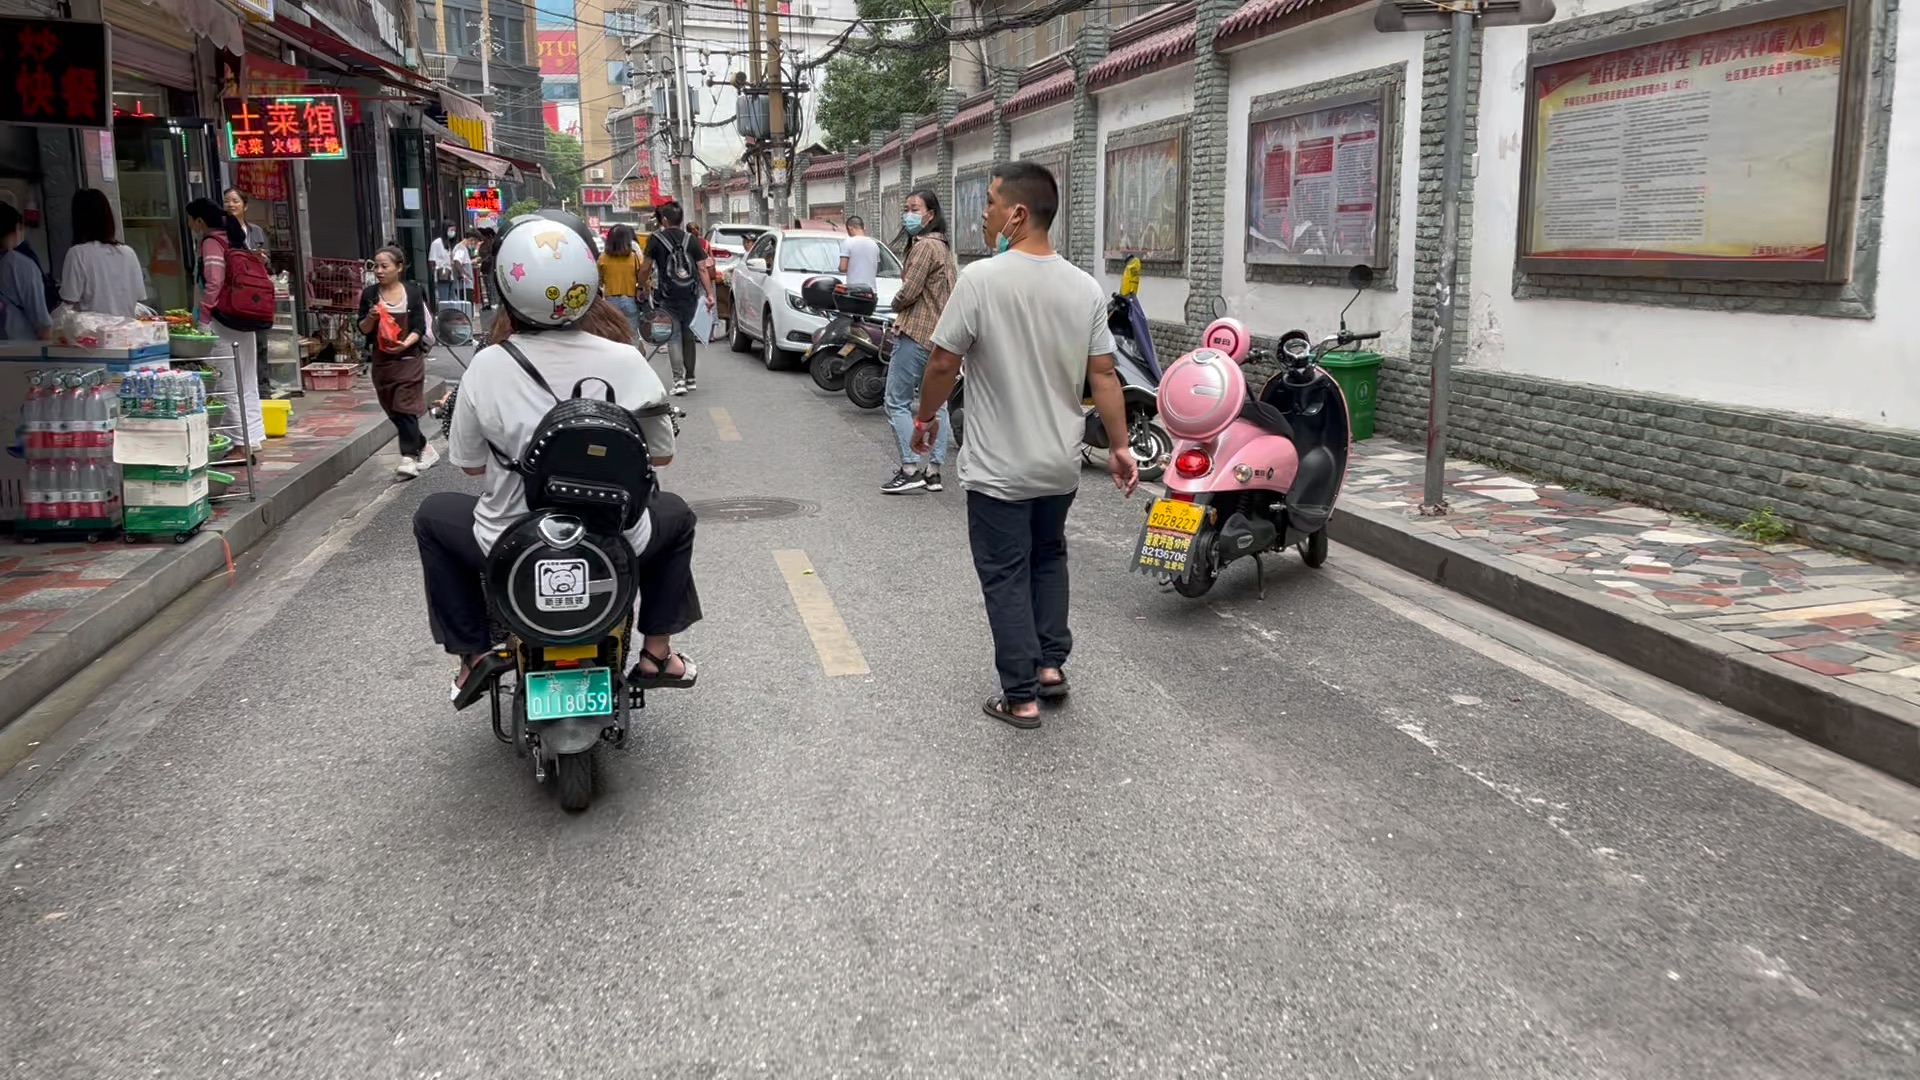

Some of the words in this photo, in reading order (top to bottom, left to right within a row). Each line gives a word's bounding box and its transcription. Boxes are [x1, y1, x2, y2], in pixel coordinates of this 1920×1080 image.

[15, 64, 98, 120] 快餐
[231, 101, 336, 137] 土菜馆
[234, 137, 265, 155] 点菜
[271, 137, 303, 154] 火锅
[1151, 512, 1197, 530] 9028227
[1141, 546, 1187, 563] 82136706
[532, 691, 609, 715] 0118059
